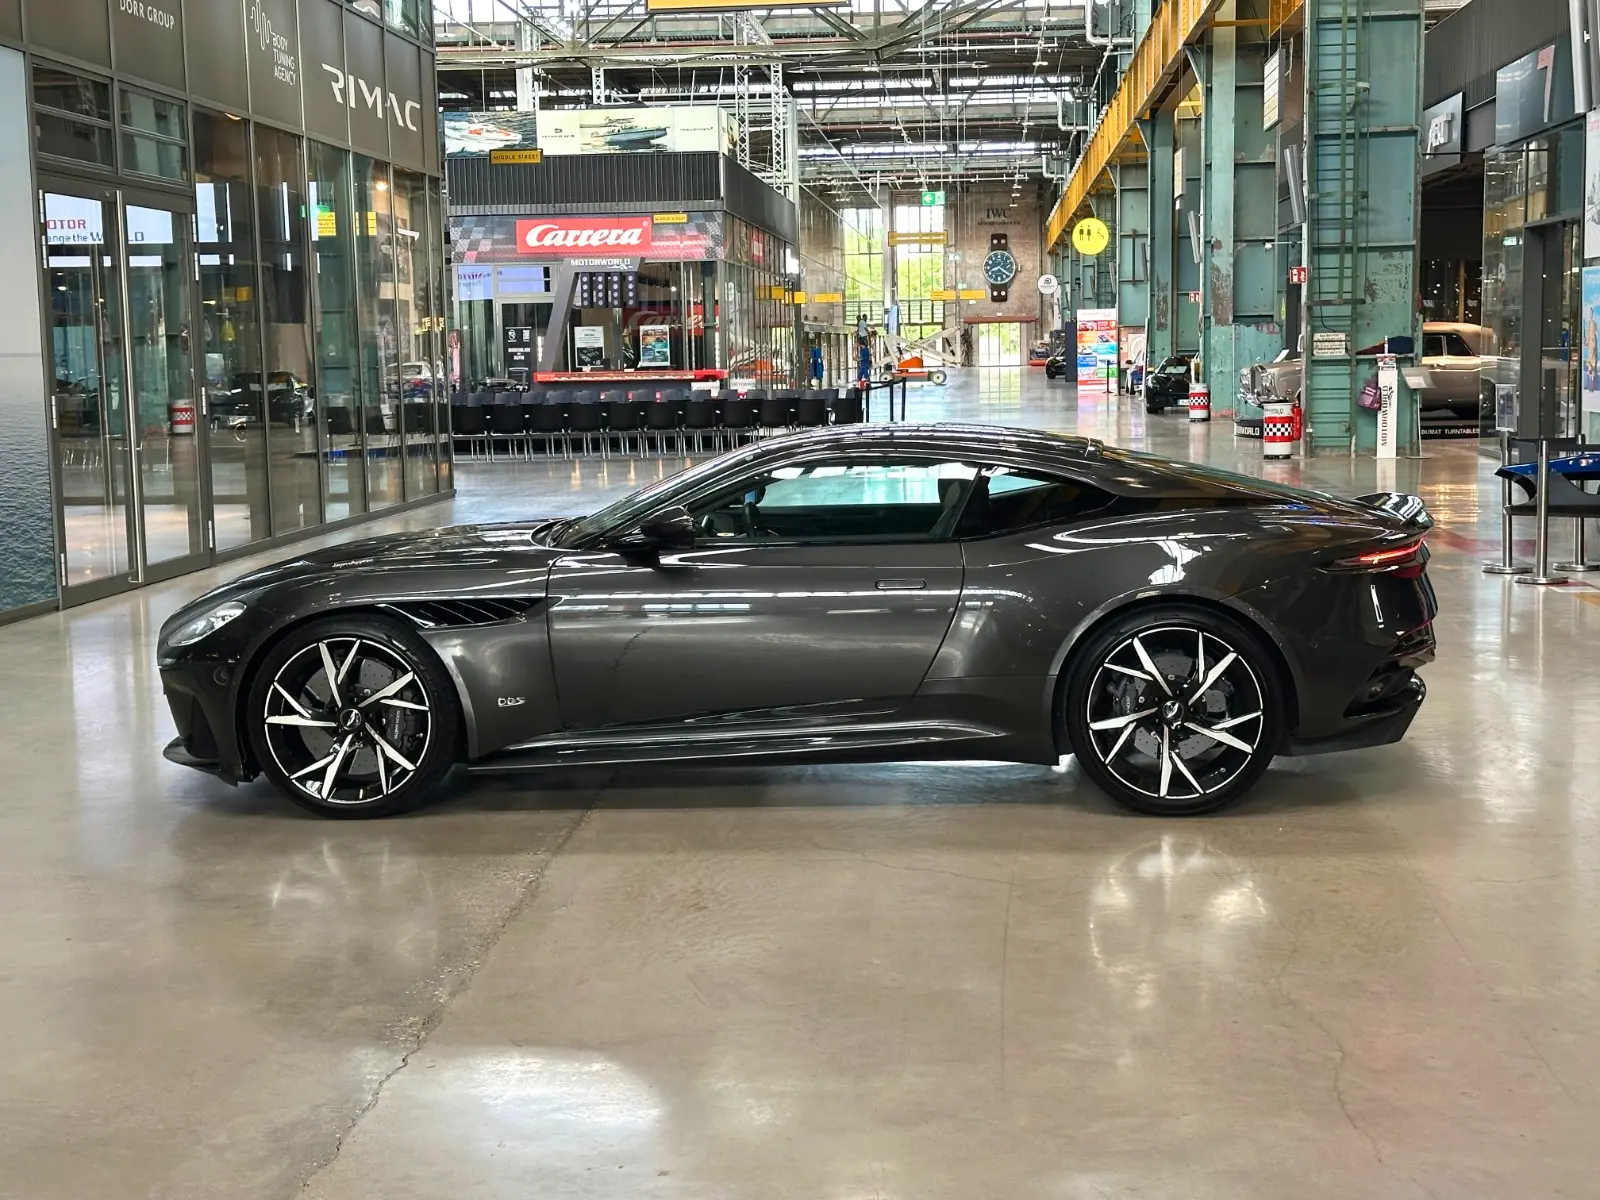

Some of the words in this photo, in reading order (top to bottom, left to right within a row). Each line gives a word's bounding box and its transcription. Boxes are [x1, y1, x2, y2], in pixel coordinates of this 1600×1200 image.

[147, 6, 174, 29] GROUP
[273, 34, 289, 51] BODY
[273, 48, 295, 70] TUNING
[274, 64, 297, 86] AGENCY
[321, 62, 421, 132] RIMAC
[987, 207, 1012, 219] IWC
[46, 219, 87, 229] OTOR
[73, 233, 88, 243] the
[525, 223, 644, 248] Carrera
[570, 258, 632, 267] MOTORWORLD
[1444, 427, 1480, 435] TURNTABLES
